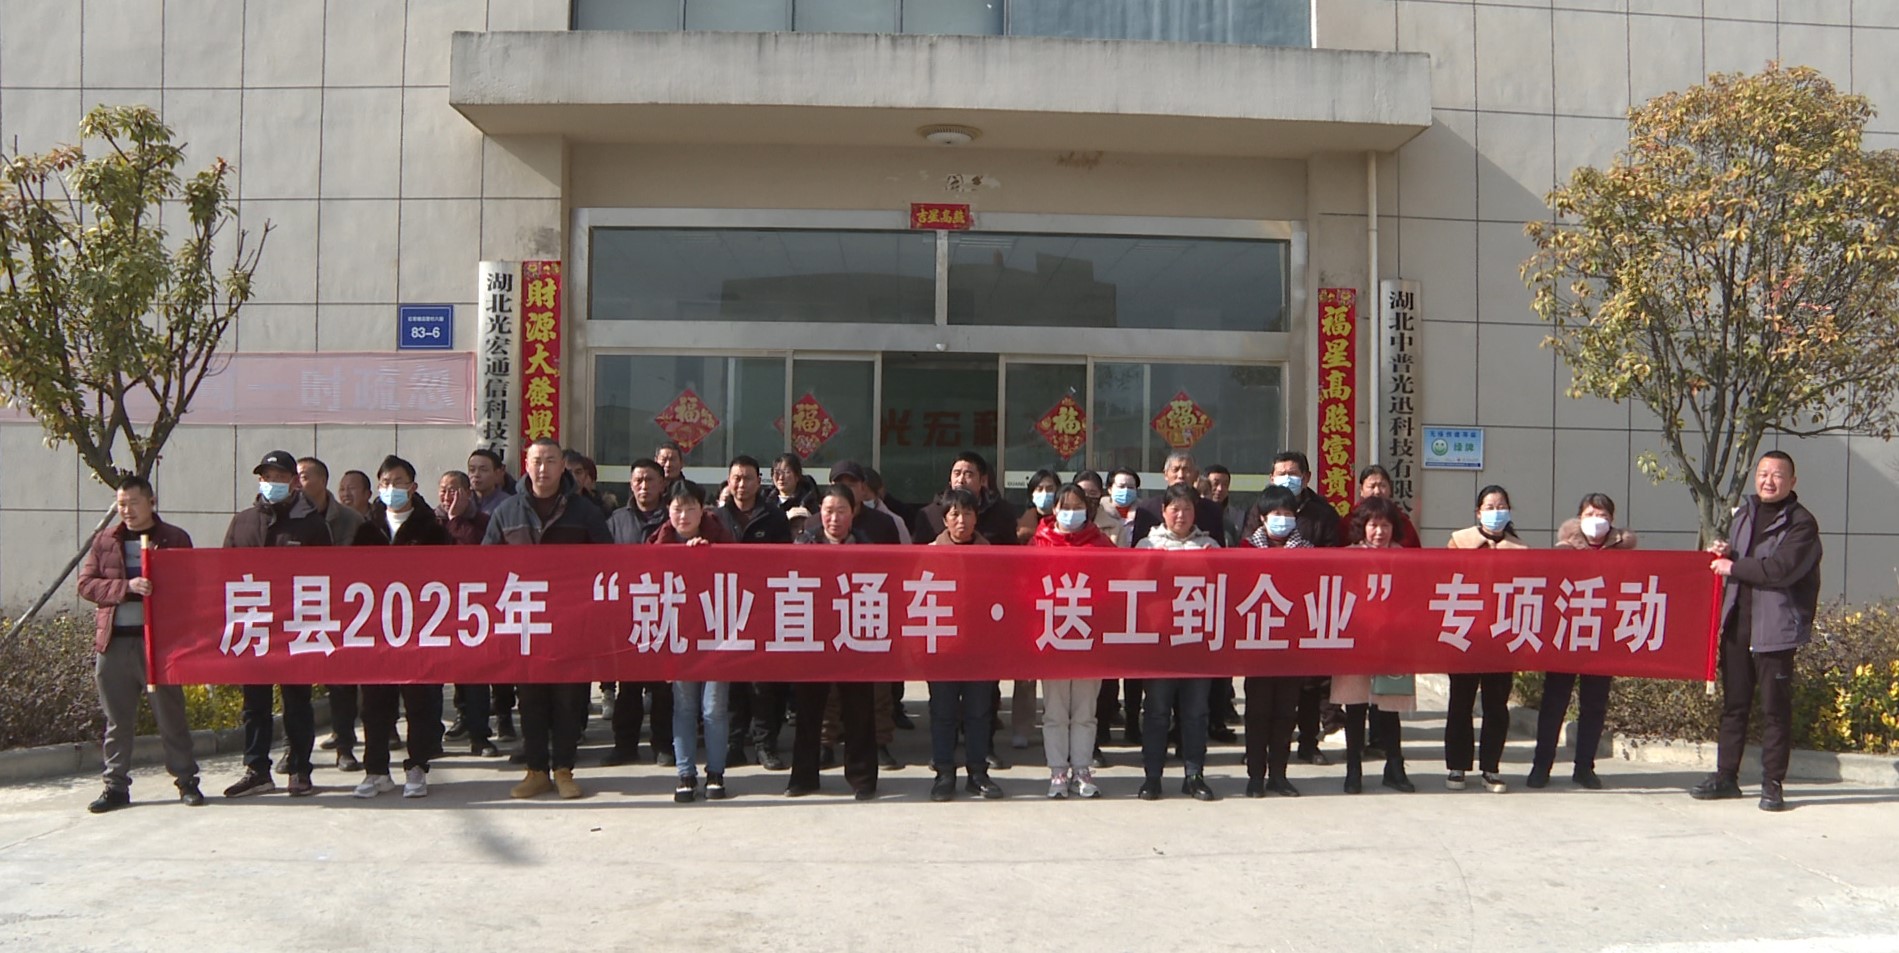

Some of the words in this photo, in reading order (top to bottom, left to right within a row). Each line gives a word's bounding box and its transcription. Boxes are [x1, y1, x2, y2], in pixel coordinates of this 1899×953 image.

[916, 208, 966, 224] 吉星高照
[411, 326, 441, 338] 83-6
[674, 396, 701, 424] 福
[792, 403, 821, 433] 福
[1053, 406, 1081, 435] 福
